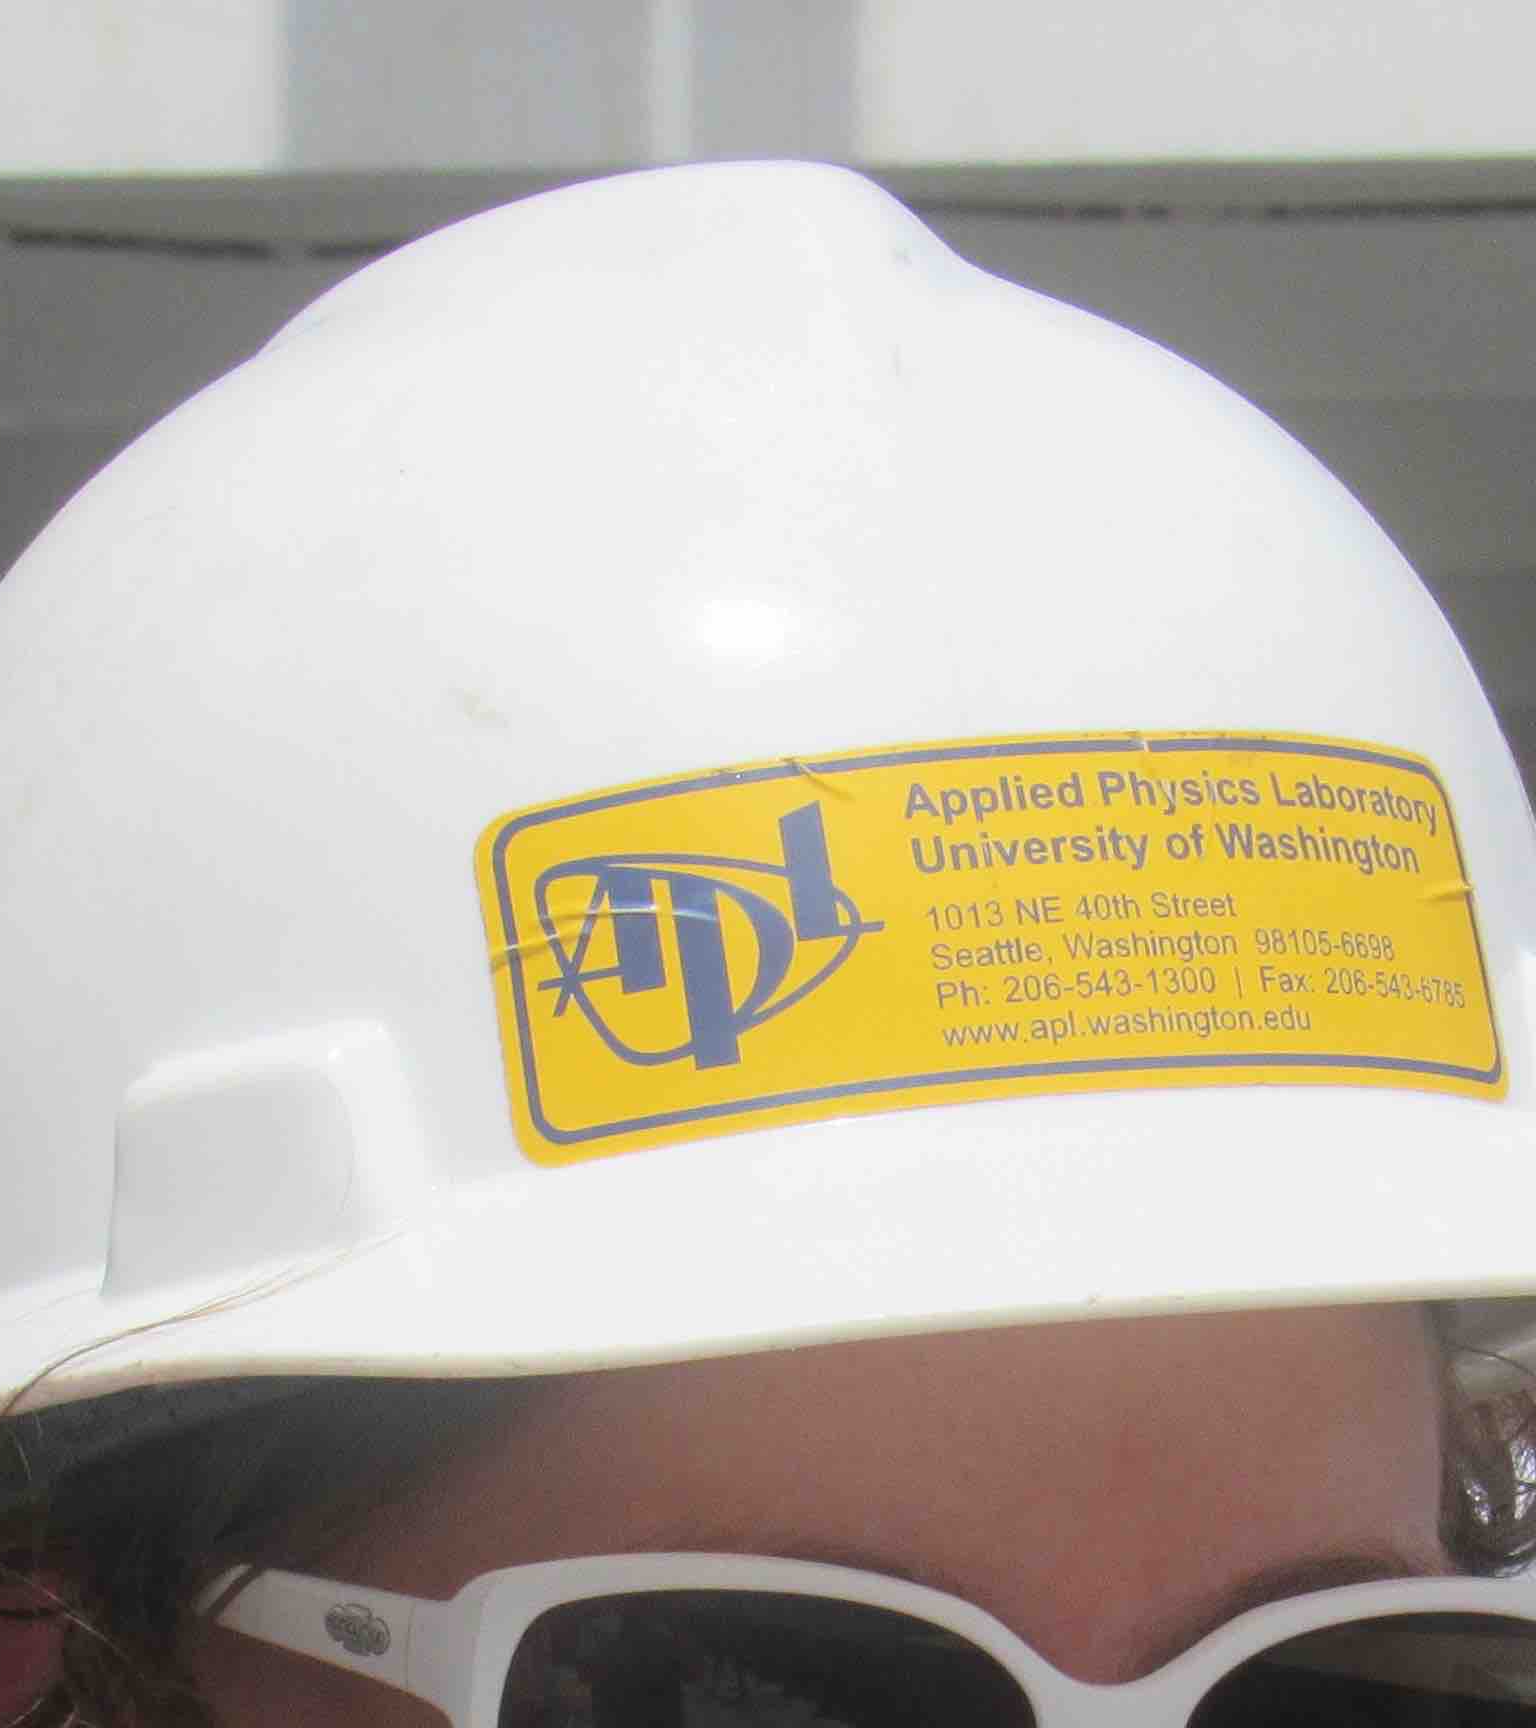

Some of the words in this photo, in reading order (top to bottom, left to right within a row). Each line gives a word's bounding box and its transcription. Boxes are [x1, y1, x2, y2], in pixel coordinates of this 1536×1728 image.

[904, 771, 1085, 825] Applied
[1096, 769, 1261, 816] Physics
[1270, 771, 1437, 837] Laboratory
[911, 824, 1149, 874] University
[1166, 823, 1205, 860] of
[1215, 823, 1421, 875] Washington
[927, 899, 1004, 932] 1013
[1016, 896, 1064, 926] NE
[1075, 893, 1142, 921] 40th
[1151, 891, 1237, 919] Street
[930, 937, 1054, 971] Seattle,
[1062, 929, 1238, 962] Washington
[1254, 928, 1396, 961] 98105-6698
[936, 979, 992, 1009] Ph:
[1003, 965, 1217, 1004] 206-543-1300
[1324, 966, 1466, 1009] 206-543-6785
[941, 1003, 1312, 1047] www.apl.washington.edu
